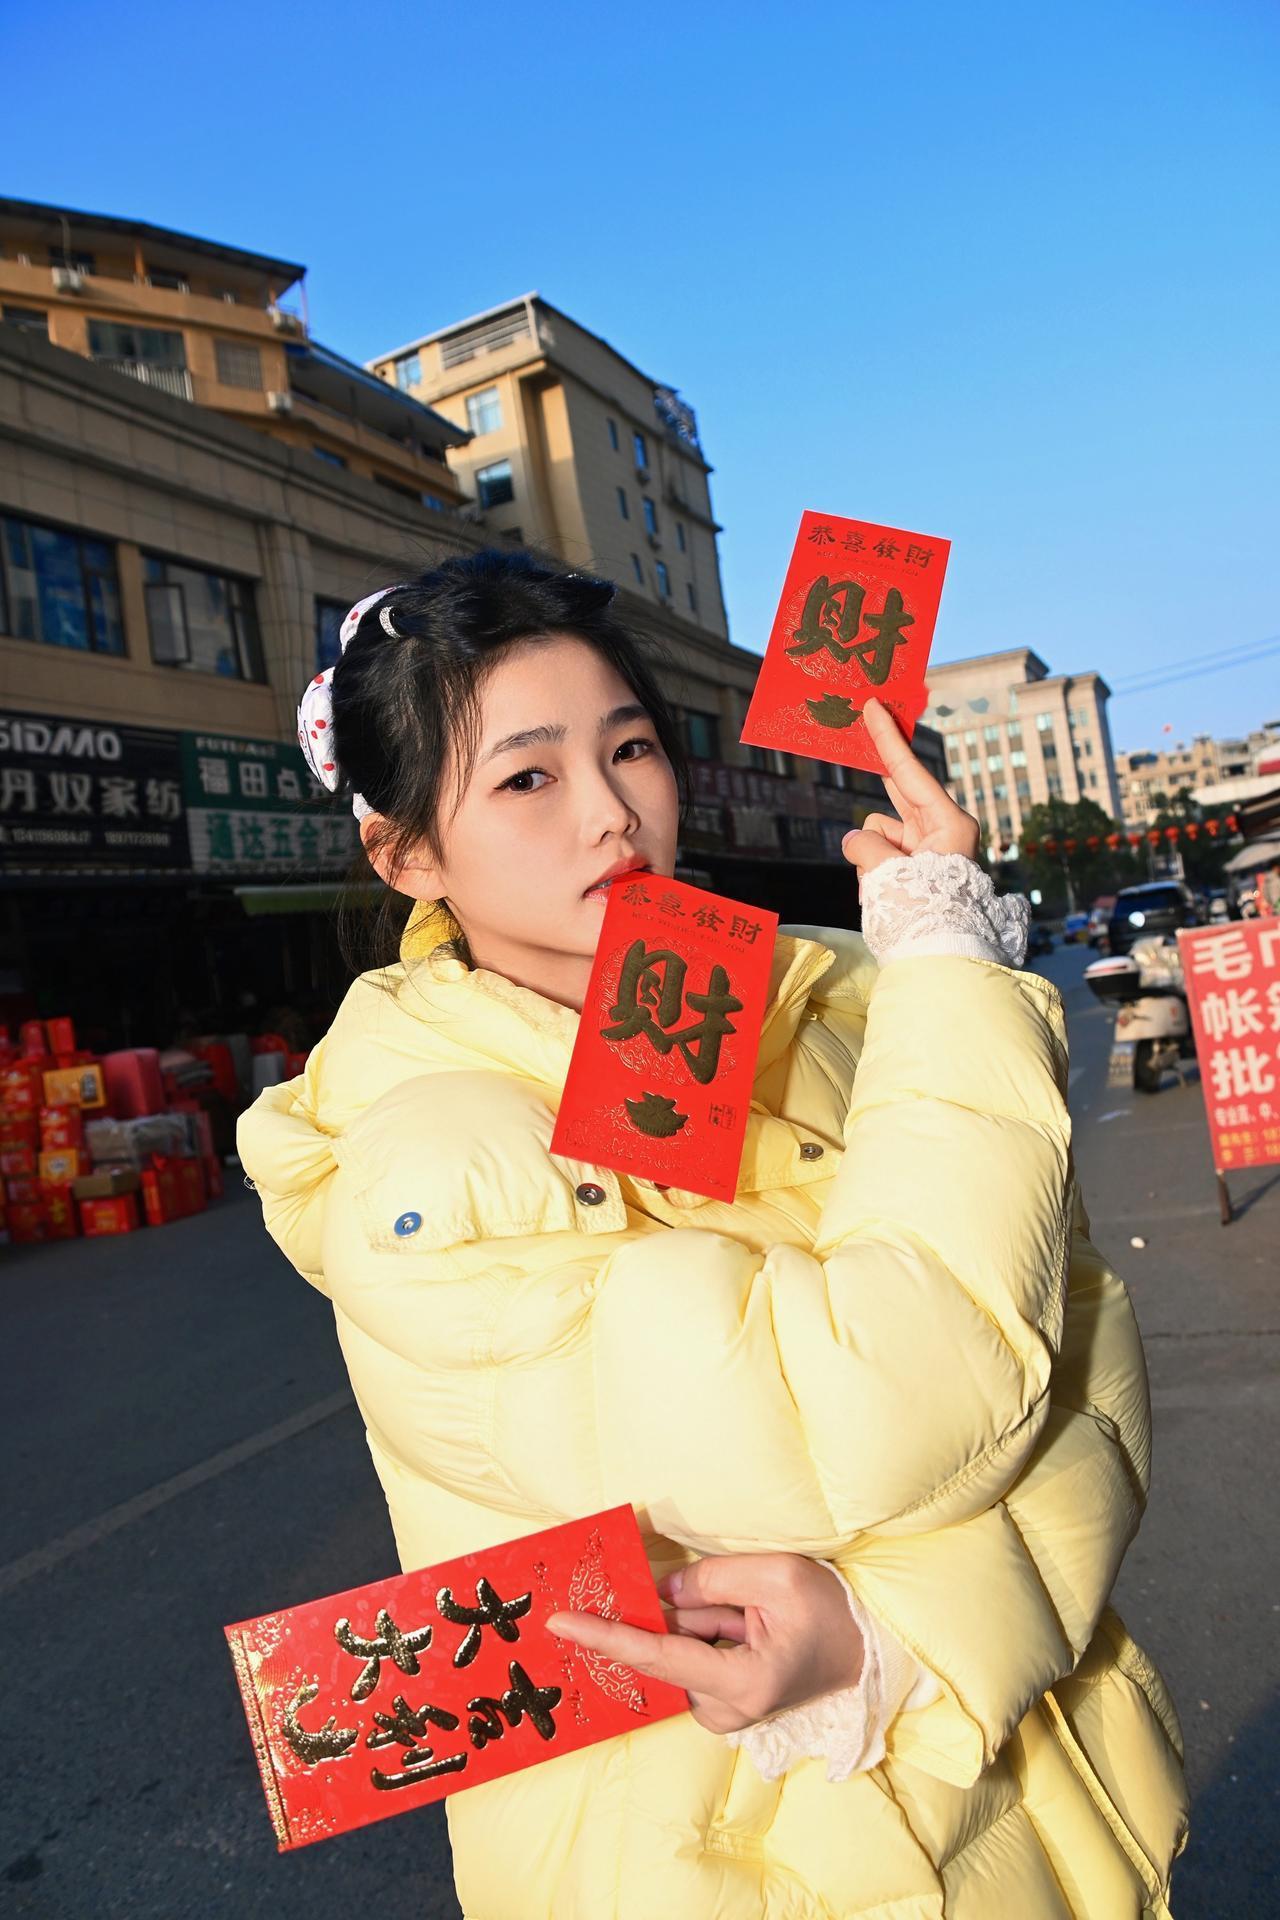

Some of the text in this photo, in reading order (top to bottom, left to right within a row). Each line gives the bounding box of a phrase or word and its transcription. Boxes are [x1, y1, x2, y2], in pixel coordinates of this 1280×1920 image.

[807, 525, 934, 569] 恭喜發財
[621, 883, 763, 945] 恭喜發財
[1211, 1043, 1280, 1100] 批
[436, 1577, 563, 1749] 大吉
